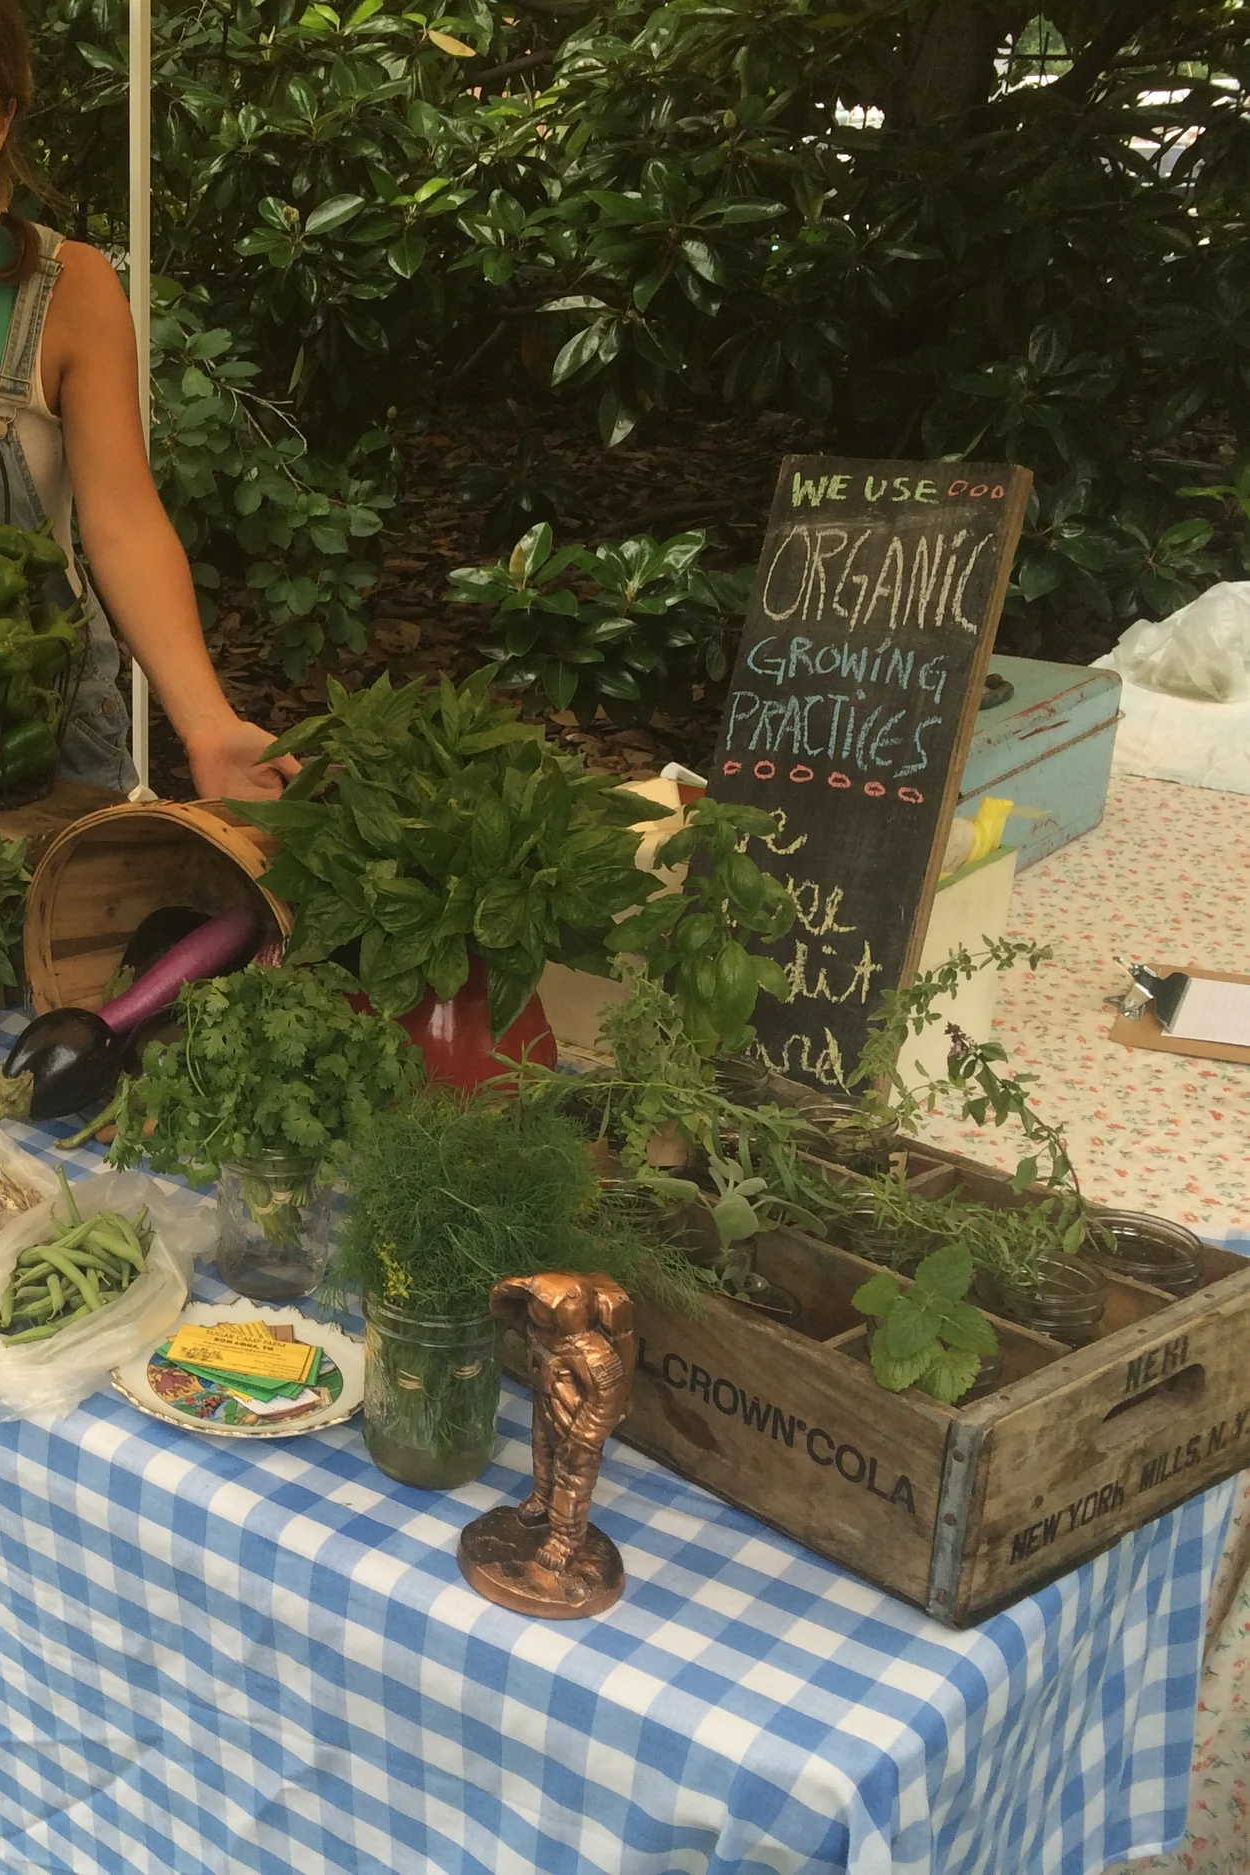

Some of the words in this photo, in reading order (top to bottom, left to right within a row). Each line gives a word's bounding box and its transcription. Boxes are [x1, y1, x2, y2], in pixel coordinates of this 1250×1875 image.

[792, 472, 853, 507] WE
[864, 475, 939, 504] USE
[205, 1329, 235, 1340] SUGAR
[236, 1335, 262, 1344] CAMP
[262, 1340, 287, 1349] FARM
[805, 1427, 917, 1516] COLA
